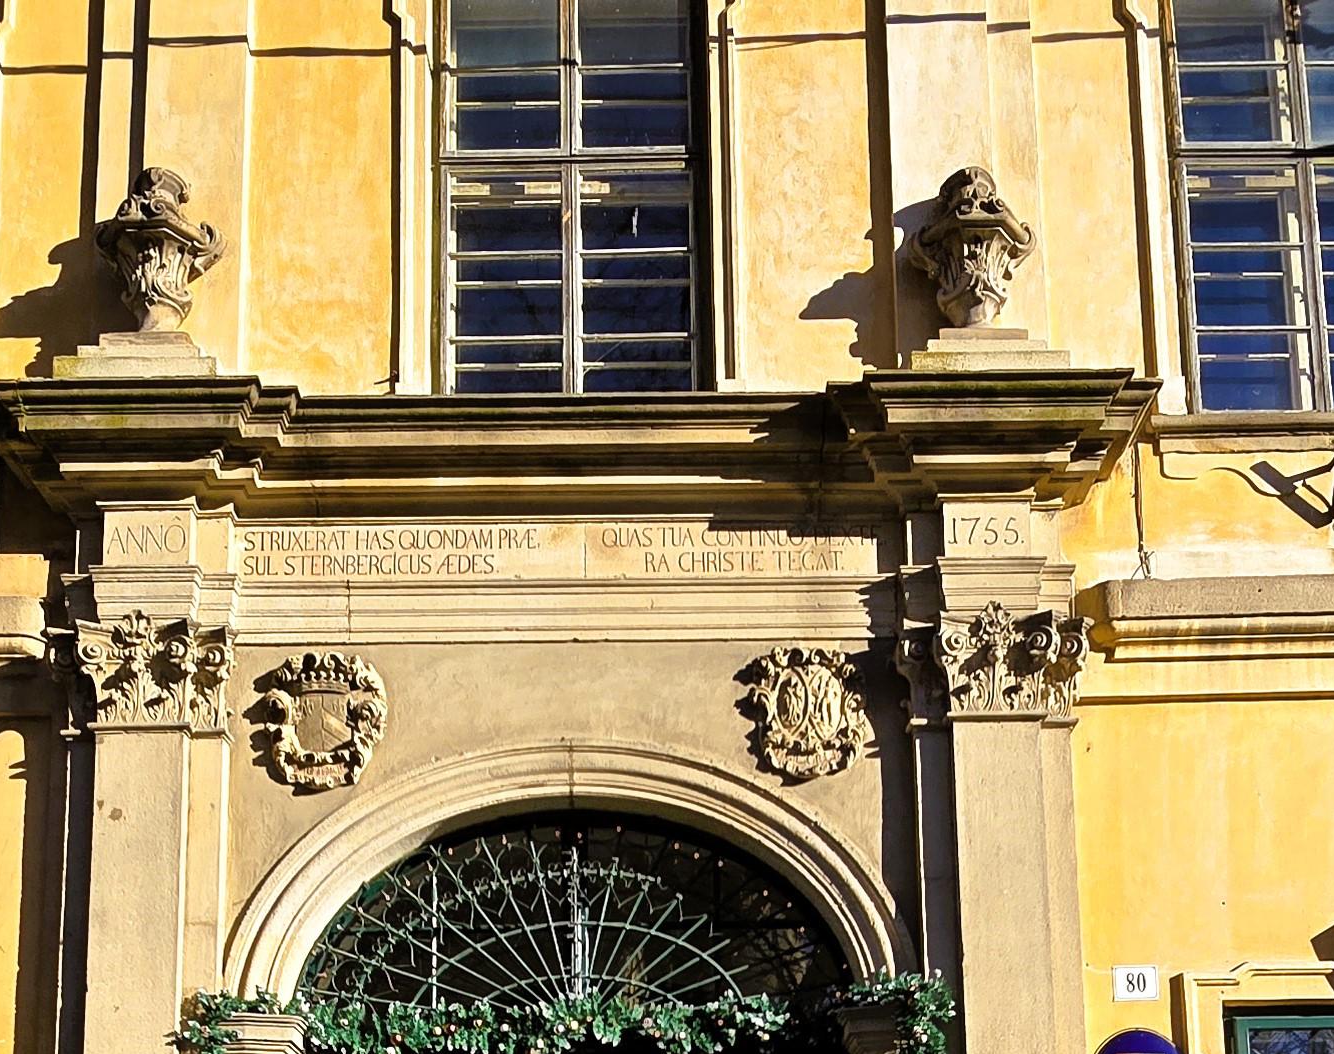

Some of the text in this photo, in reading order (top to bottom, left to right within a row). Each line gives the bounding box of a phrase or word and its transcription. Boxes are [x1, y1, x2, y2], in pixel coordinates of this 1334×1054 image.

[244, 530, 350, 552] STRUXERAT
[355, 529, 394, 551] HAS
[398, 528, 493, 550] QUONDAM
[602, 527, 653, 548] QUAS
[657, 526, 695, 548] TUA
[243, 556, 278, 576] SUL
[644, 551, 670, 573] RA
[1126, 972, 1147, 994] 80
